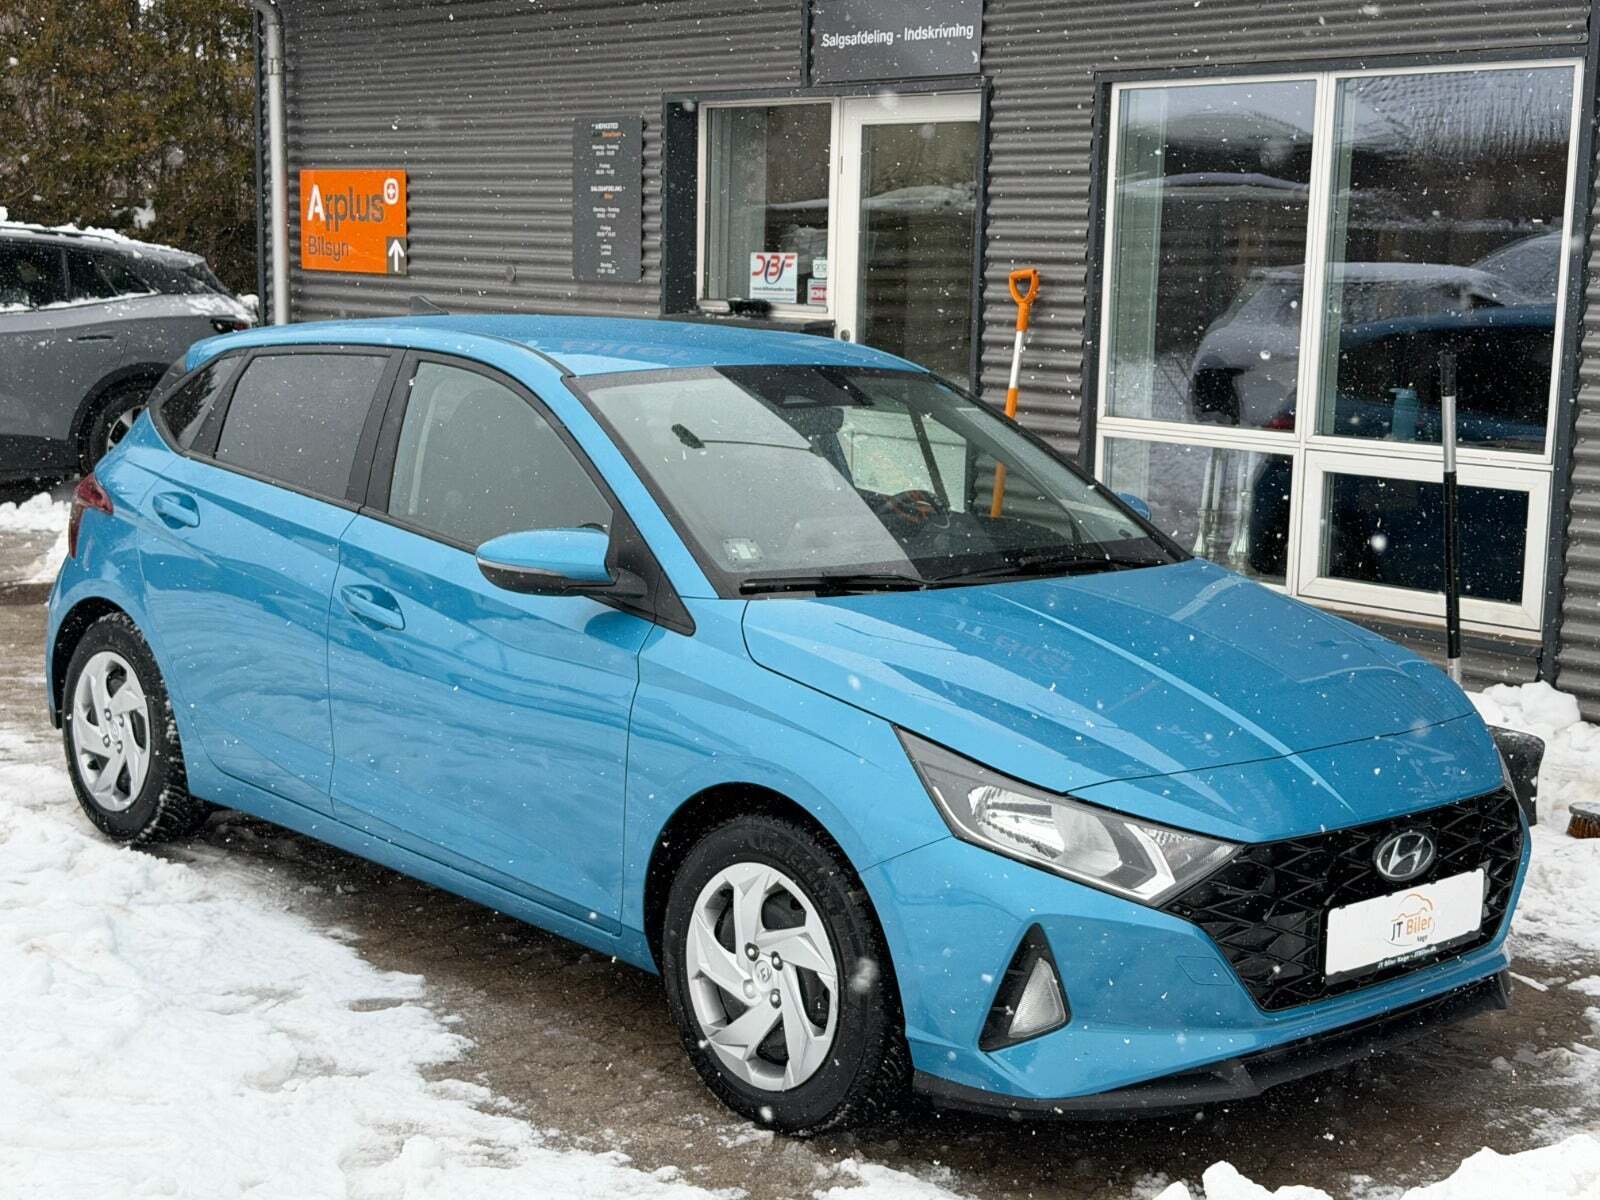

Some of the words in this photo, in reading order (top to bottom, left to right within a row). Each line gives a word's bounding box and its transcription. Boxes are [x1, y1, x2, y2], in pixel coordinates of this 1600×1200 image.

[821, 29, 894, 49] Salgsafdeling
[904, 23, 974, 41] Indskrivning
[308, 235, 350, 262] Bilsyn
[1390, 921, 1404, 941] JT
[1406, 916, 1433, 936] Biler
